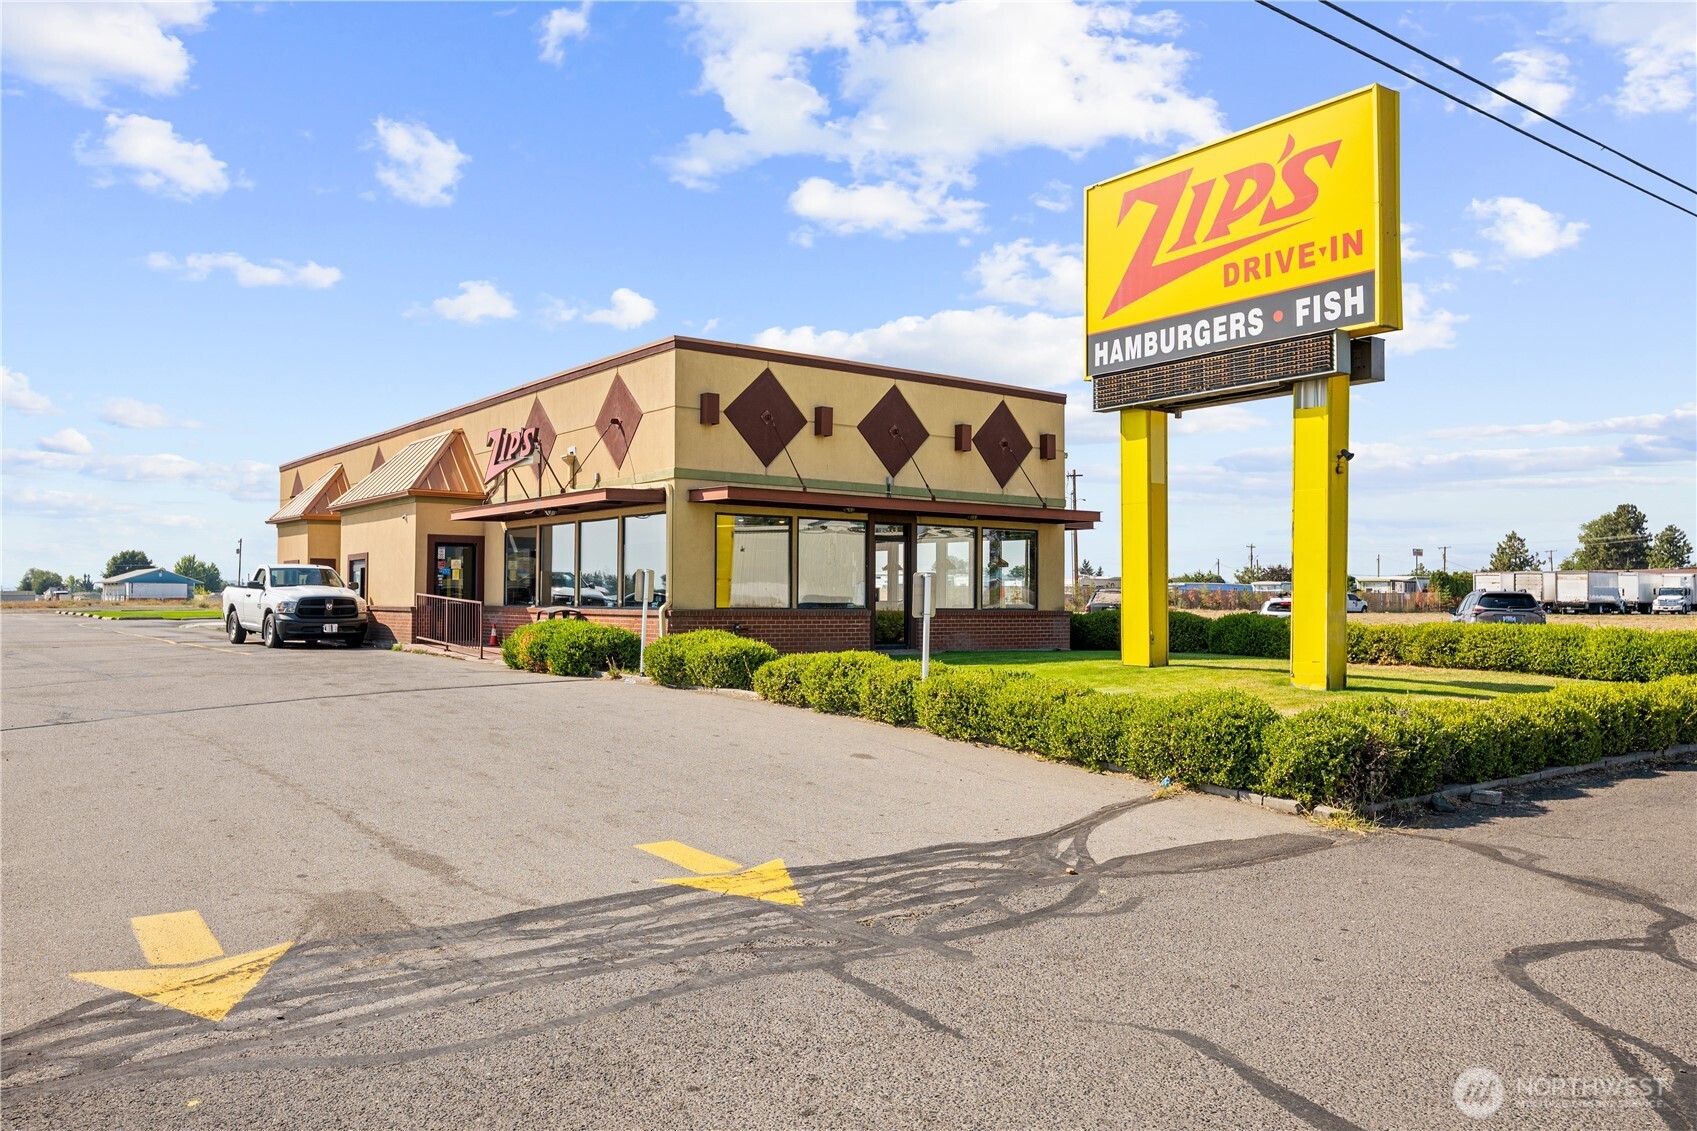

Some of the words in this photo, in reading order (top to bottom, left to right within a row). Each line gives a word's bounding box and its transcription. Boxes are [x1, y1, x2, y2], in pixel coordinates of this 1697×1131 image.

[1102, 133, 1343, 320] ZIP'S
[1094, 308, 1264, 367] HAMBURGERS
[1296, 285, 1365, 327] FISH
[484, 427, 540, 484] ZIP'S
